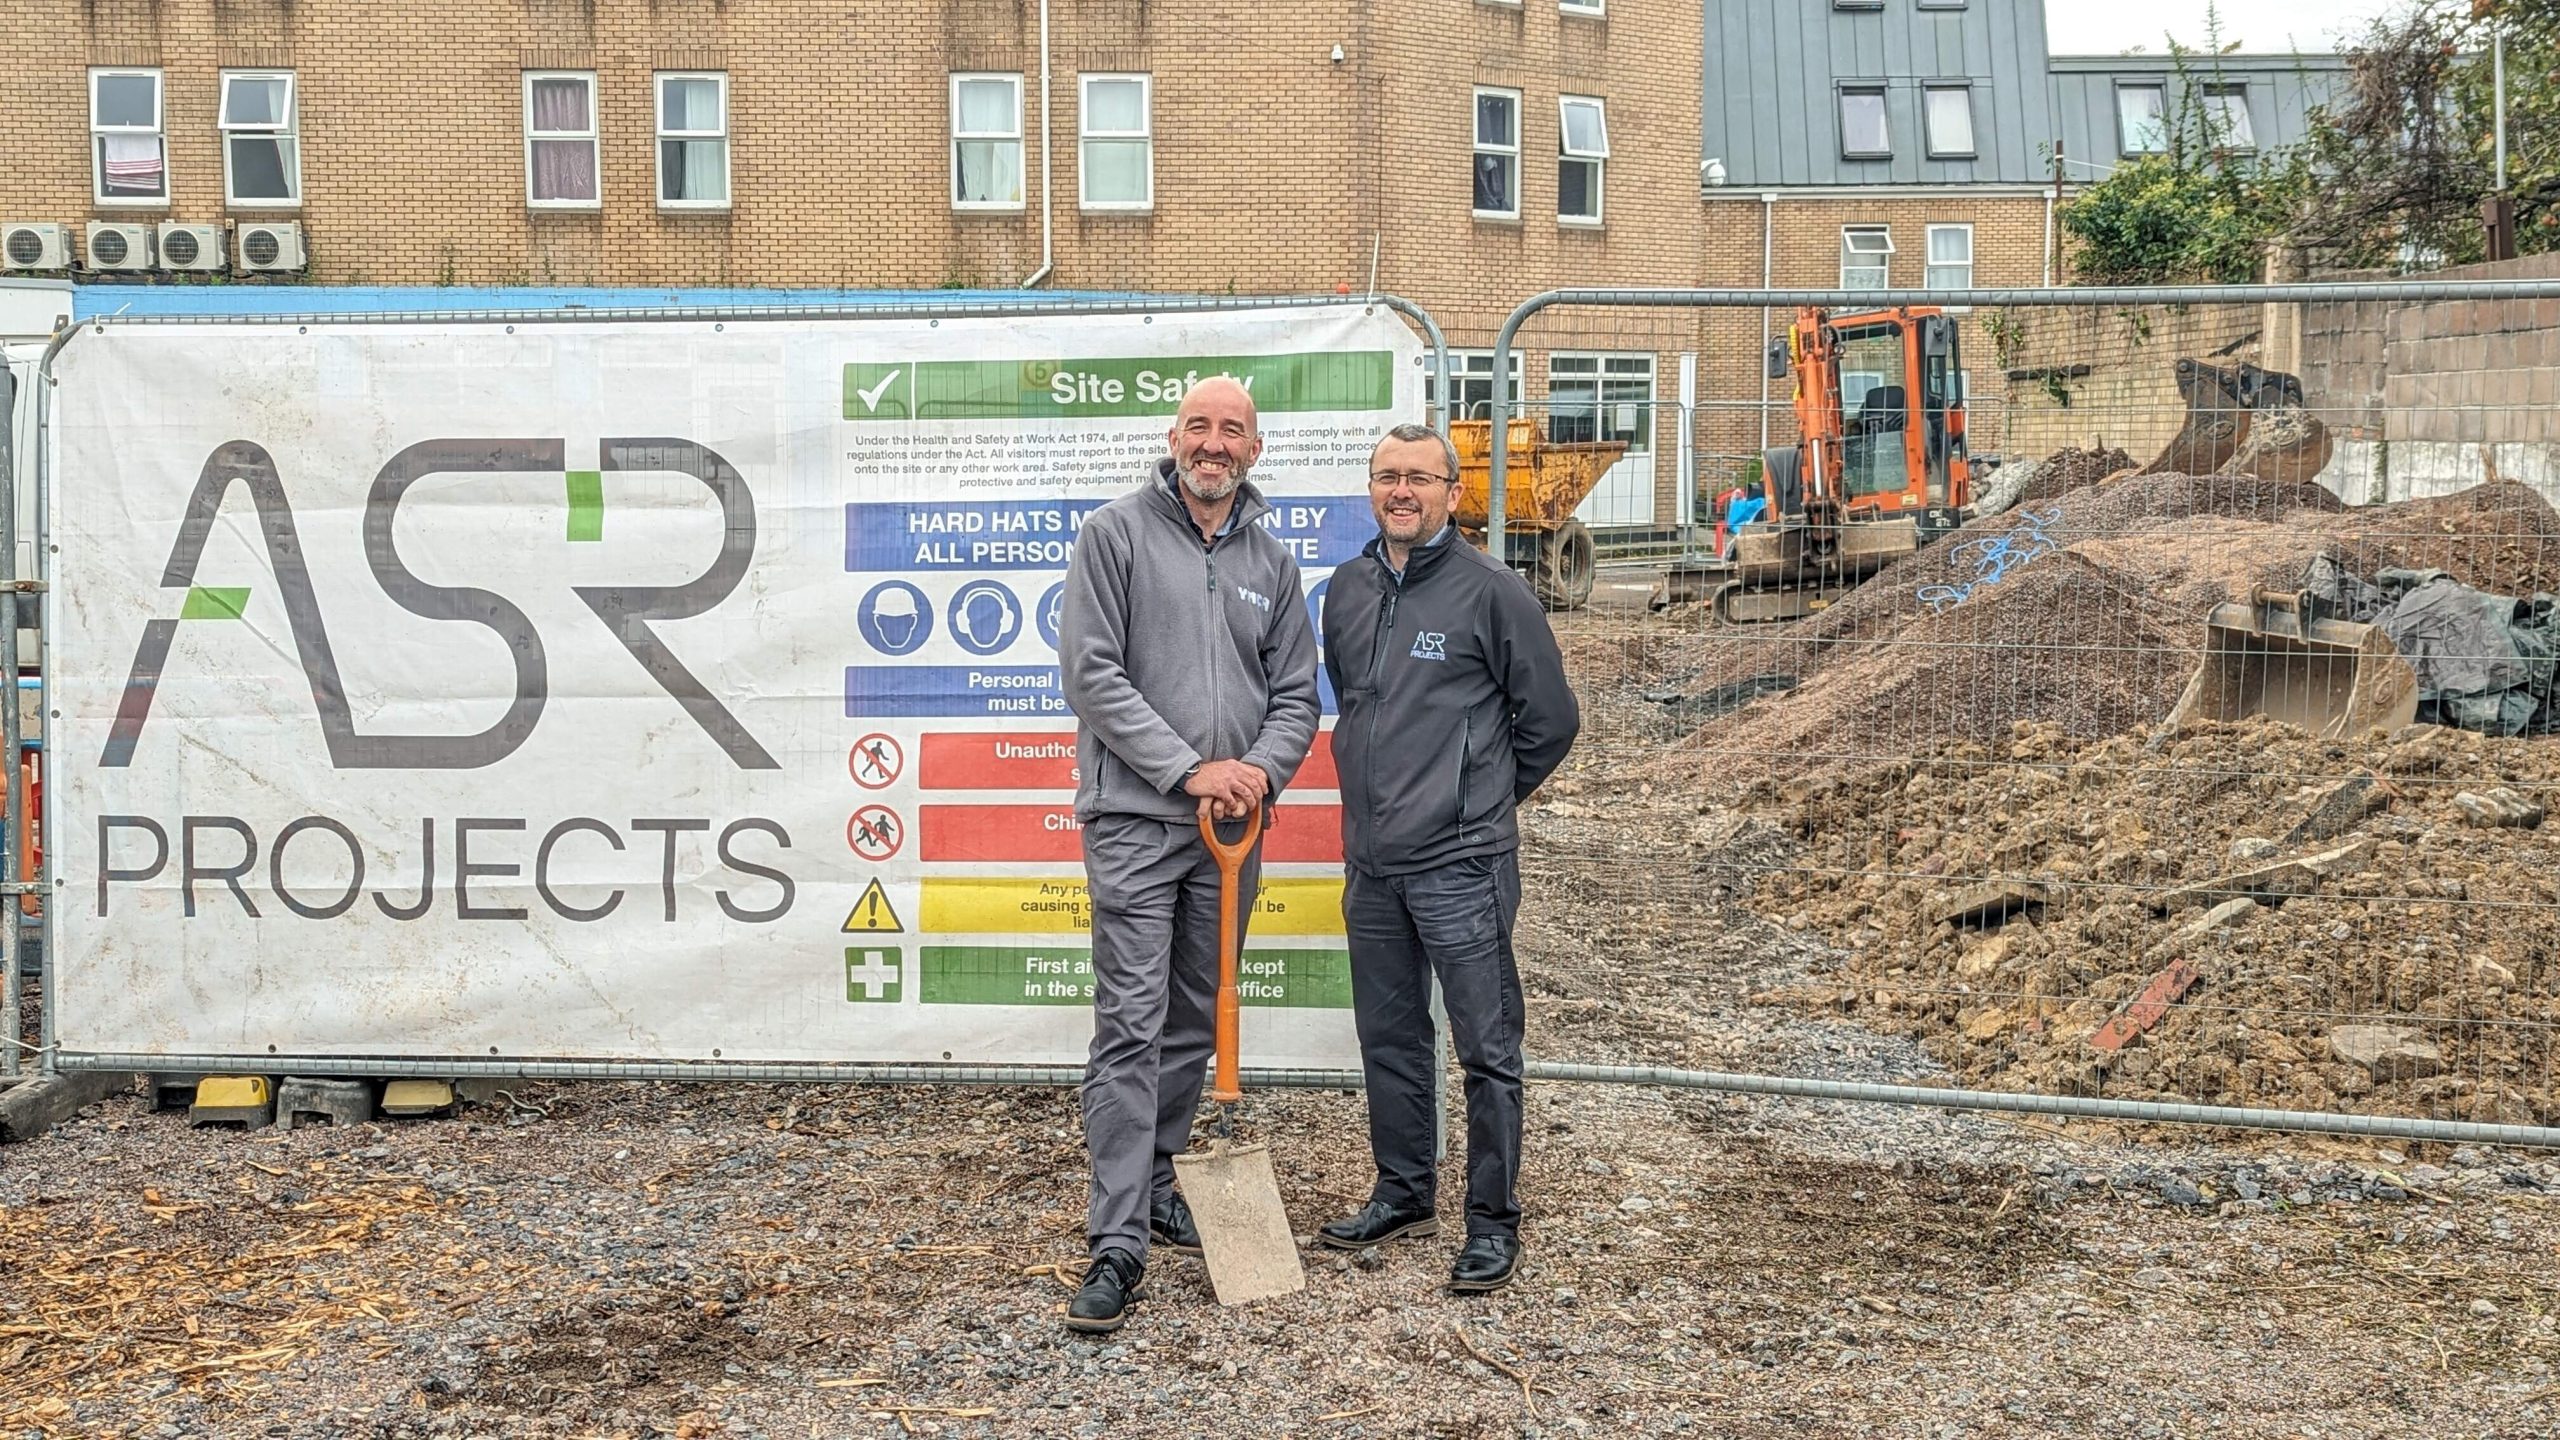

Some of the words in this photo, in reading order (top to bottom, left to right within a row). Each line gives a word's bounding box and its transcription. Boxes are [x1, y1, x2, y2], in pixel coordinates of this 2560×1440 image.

[1051, 371, 1125, 404] Site
[855, 435, 889, 446] Under
[892, 435, 910, 445] the
[913, 434, 948, 445] Health
[951, 434, 972, 445] and
[975, 434, 1010, 447] Safety
[1012, 434, 1024, 444] at
[1027, 433, 1056, 444] Work
[1058, 433, 1077, 444] Act
[1081, 433, 1109, 445] 1974,
[1112, 432, 1125, 442] all
[1268, 428, 1296, 438] must
[1298, 427, 1340, 440] comply
[1343, 426, 1366, 437] with
[1368, 426, 1381, 436] all
[847, 449, 908, 462] regulations
[911, 449, 942, 460] under
[945, 449, 963, 459] the
[965, 449, 987, 459] Act.
[990, 448, 1004, 459] All
[1007, 448, 1046, 459] visitors
[1049, 447, 1076, 458] must
[1078, 448, 1112, 459] report
[1114, 446, 1125, 456] to
[1128, 445, 1145, 455] the
[1147, 445, 1168, 455] site
[1267, 441, 1328, 454] permission
[1331, 442, 1342, 451] to
[1345, 442, 1377, 453] proce
[854, 464, 879, 474] onto
[882, 463, 900, 474] the
[902, 463, 922, 474] site
[925, 465, 936, 474] or
[939, 465, 958, 475] any
[961, 463, 990, 474] other
[993, 463, 1020, 473] work
[1022, 463, 1049, 473] area.
[1051, 461, 1086, 474] Safety
[1089, 460, 1117, 473] signs
[1120, 459, 1140, 469] and
[1258, 456, 1310, 468] observed
[1313, 456, 1334, 467] and
[959, 477, 1014, 489] protective
[1016, 476, 1037, 487] and
[1039, 475, 1072, 487] safety
[1075, 474, 1134, 486] equipment
[910, 512, 984, 534] HARD
[991, 510, 1063, 533] HATS
[1290, 507, 1328, 529] BY
[914, 542, 965, 564] ALL
[1279, 538, 1319, 560] TE
[97, 436, 784, 771] ASR
[1412, 630, 1446, 653] ASR
[1410, 649, 1446, 661] PROJECTS
[968, 671, 1053, 689] Personal
[988, 695, 1037, 712] must
[1041, 694, 1066, 711] be
[995, 741, 1077, 759] Unautho
[96, 815, 796, 924] PROJECTS
[1040, 883, 1069, 898] Any
[1020, 899, 1080, 915] causing
[1267, 900, 1286, 913] be
[1073, 916, 1091, 929] lia
[1026, 957, 1070, 974] First
[1241, 958, 1286, 979] kept
[1024, 980, 1042, 997] in
[1047, 980, 1079, 997] the
